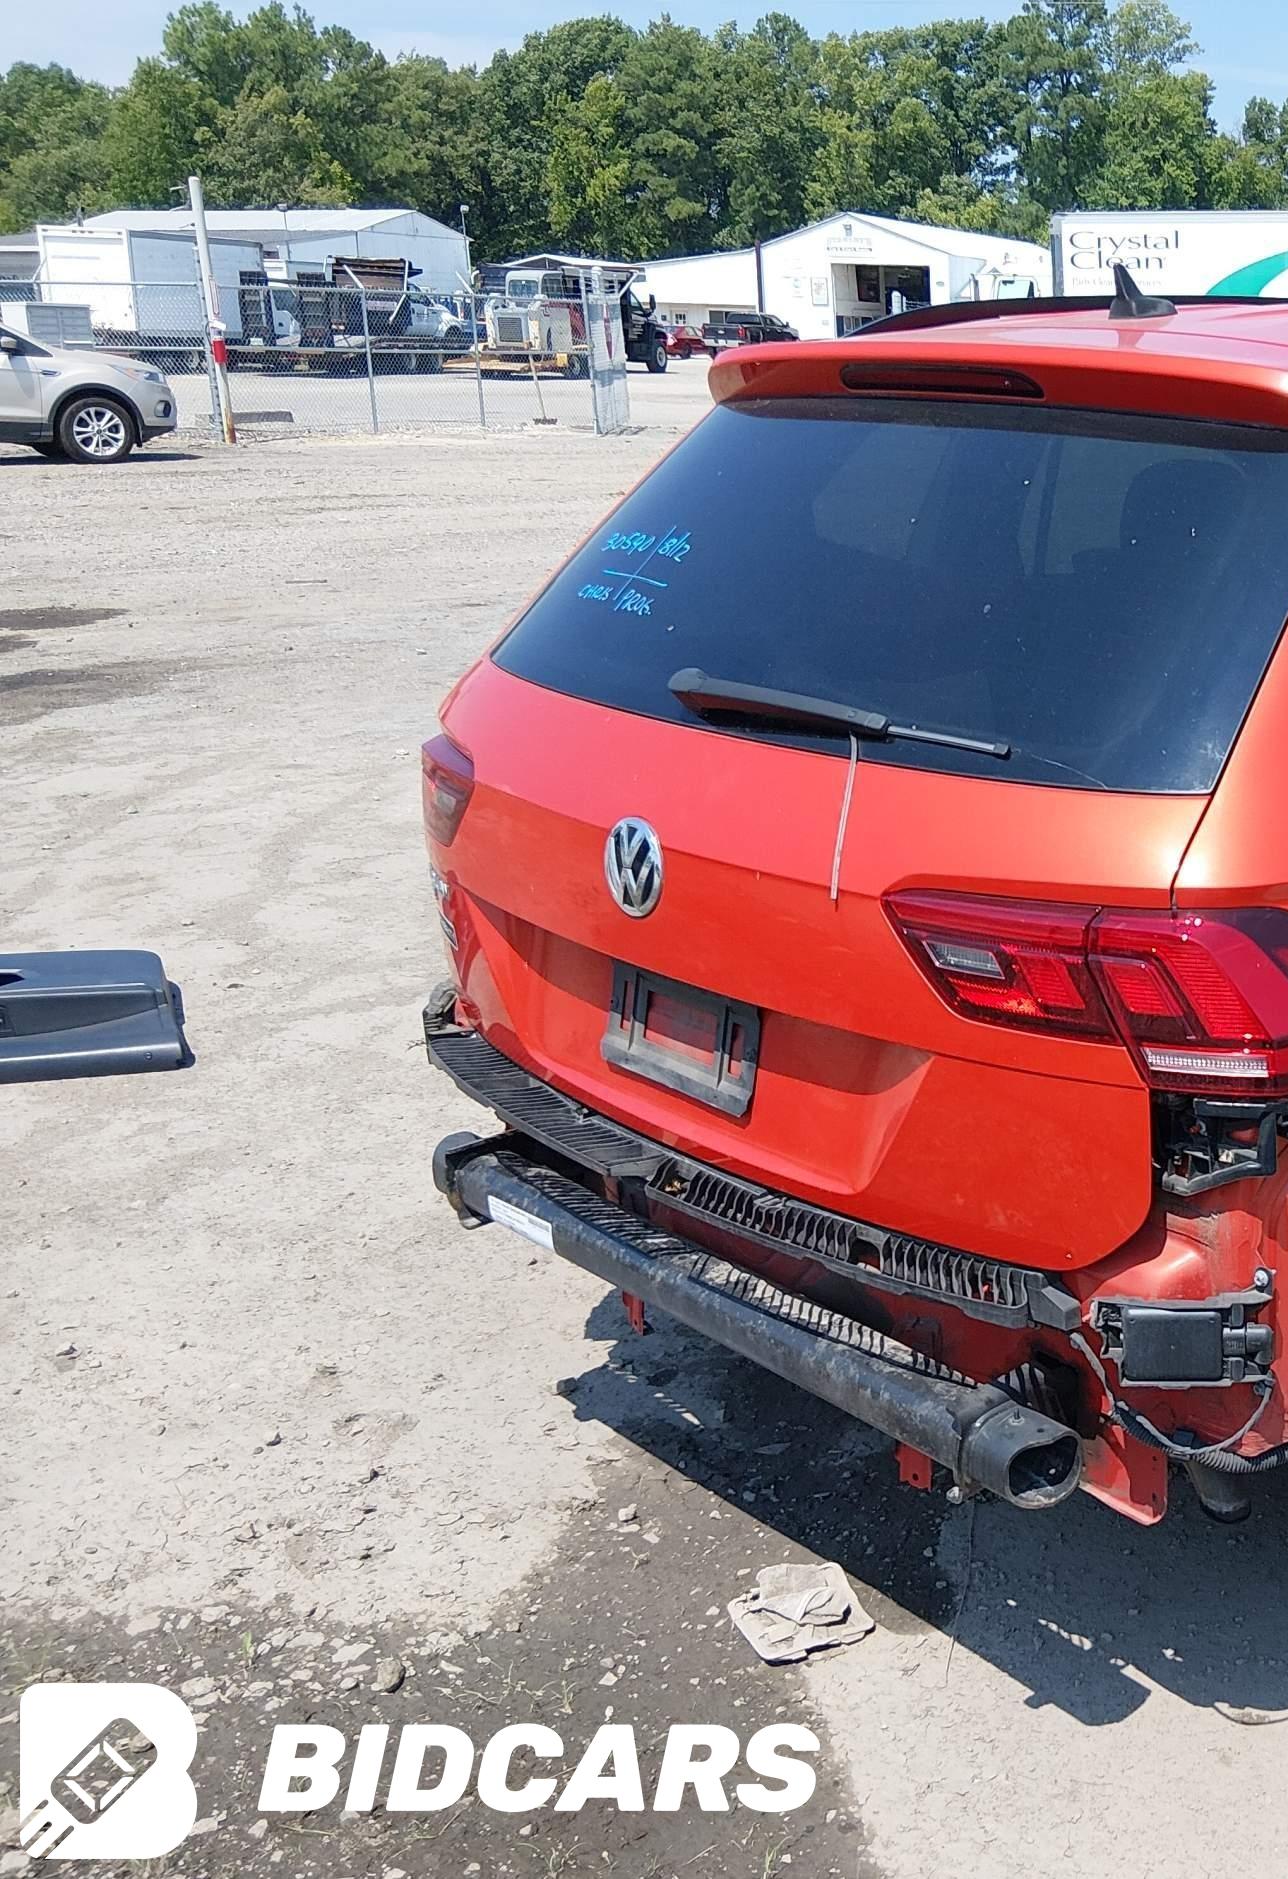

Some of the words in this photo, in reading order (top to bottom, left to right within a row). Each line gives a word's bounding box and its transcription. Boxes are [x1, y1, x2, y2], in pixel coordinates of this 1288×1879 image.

[1069, 230, 1179, 254] Crystal
[1070, 251, 1164, 270] Clean
[604, 816, 664, 918] VW
